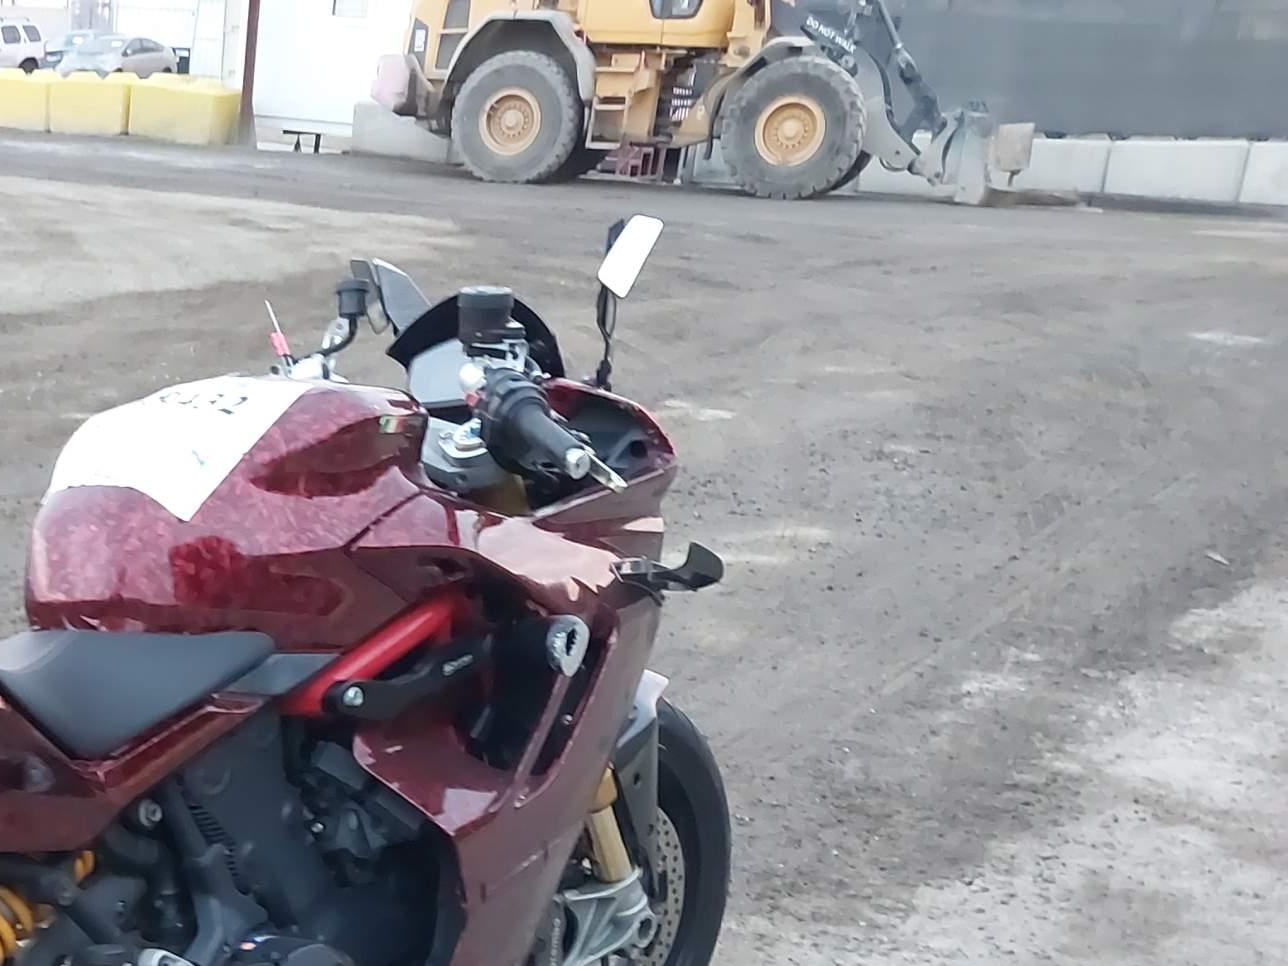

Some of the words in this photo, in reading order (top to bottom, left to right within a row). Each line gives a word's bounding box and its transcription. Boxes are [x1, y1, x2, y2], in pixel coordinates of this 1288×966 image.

[806, 15, 819, 29] DO
[818, 25, 835, 39] NOT
[834, 36, 856, 54] WALK
